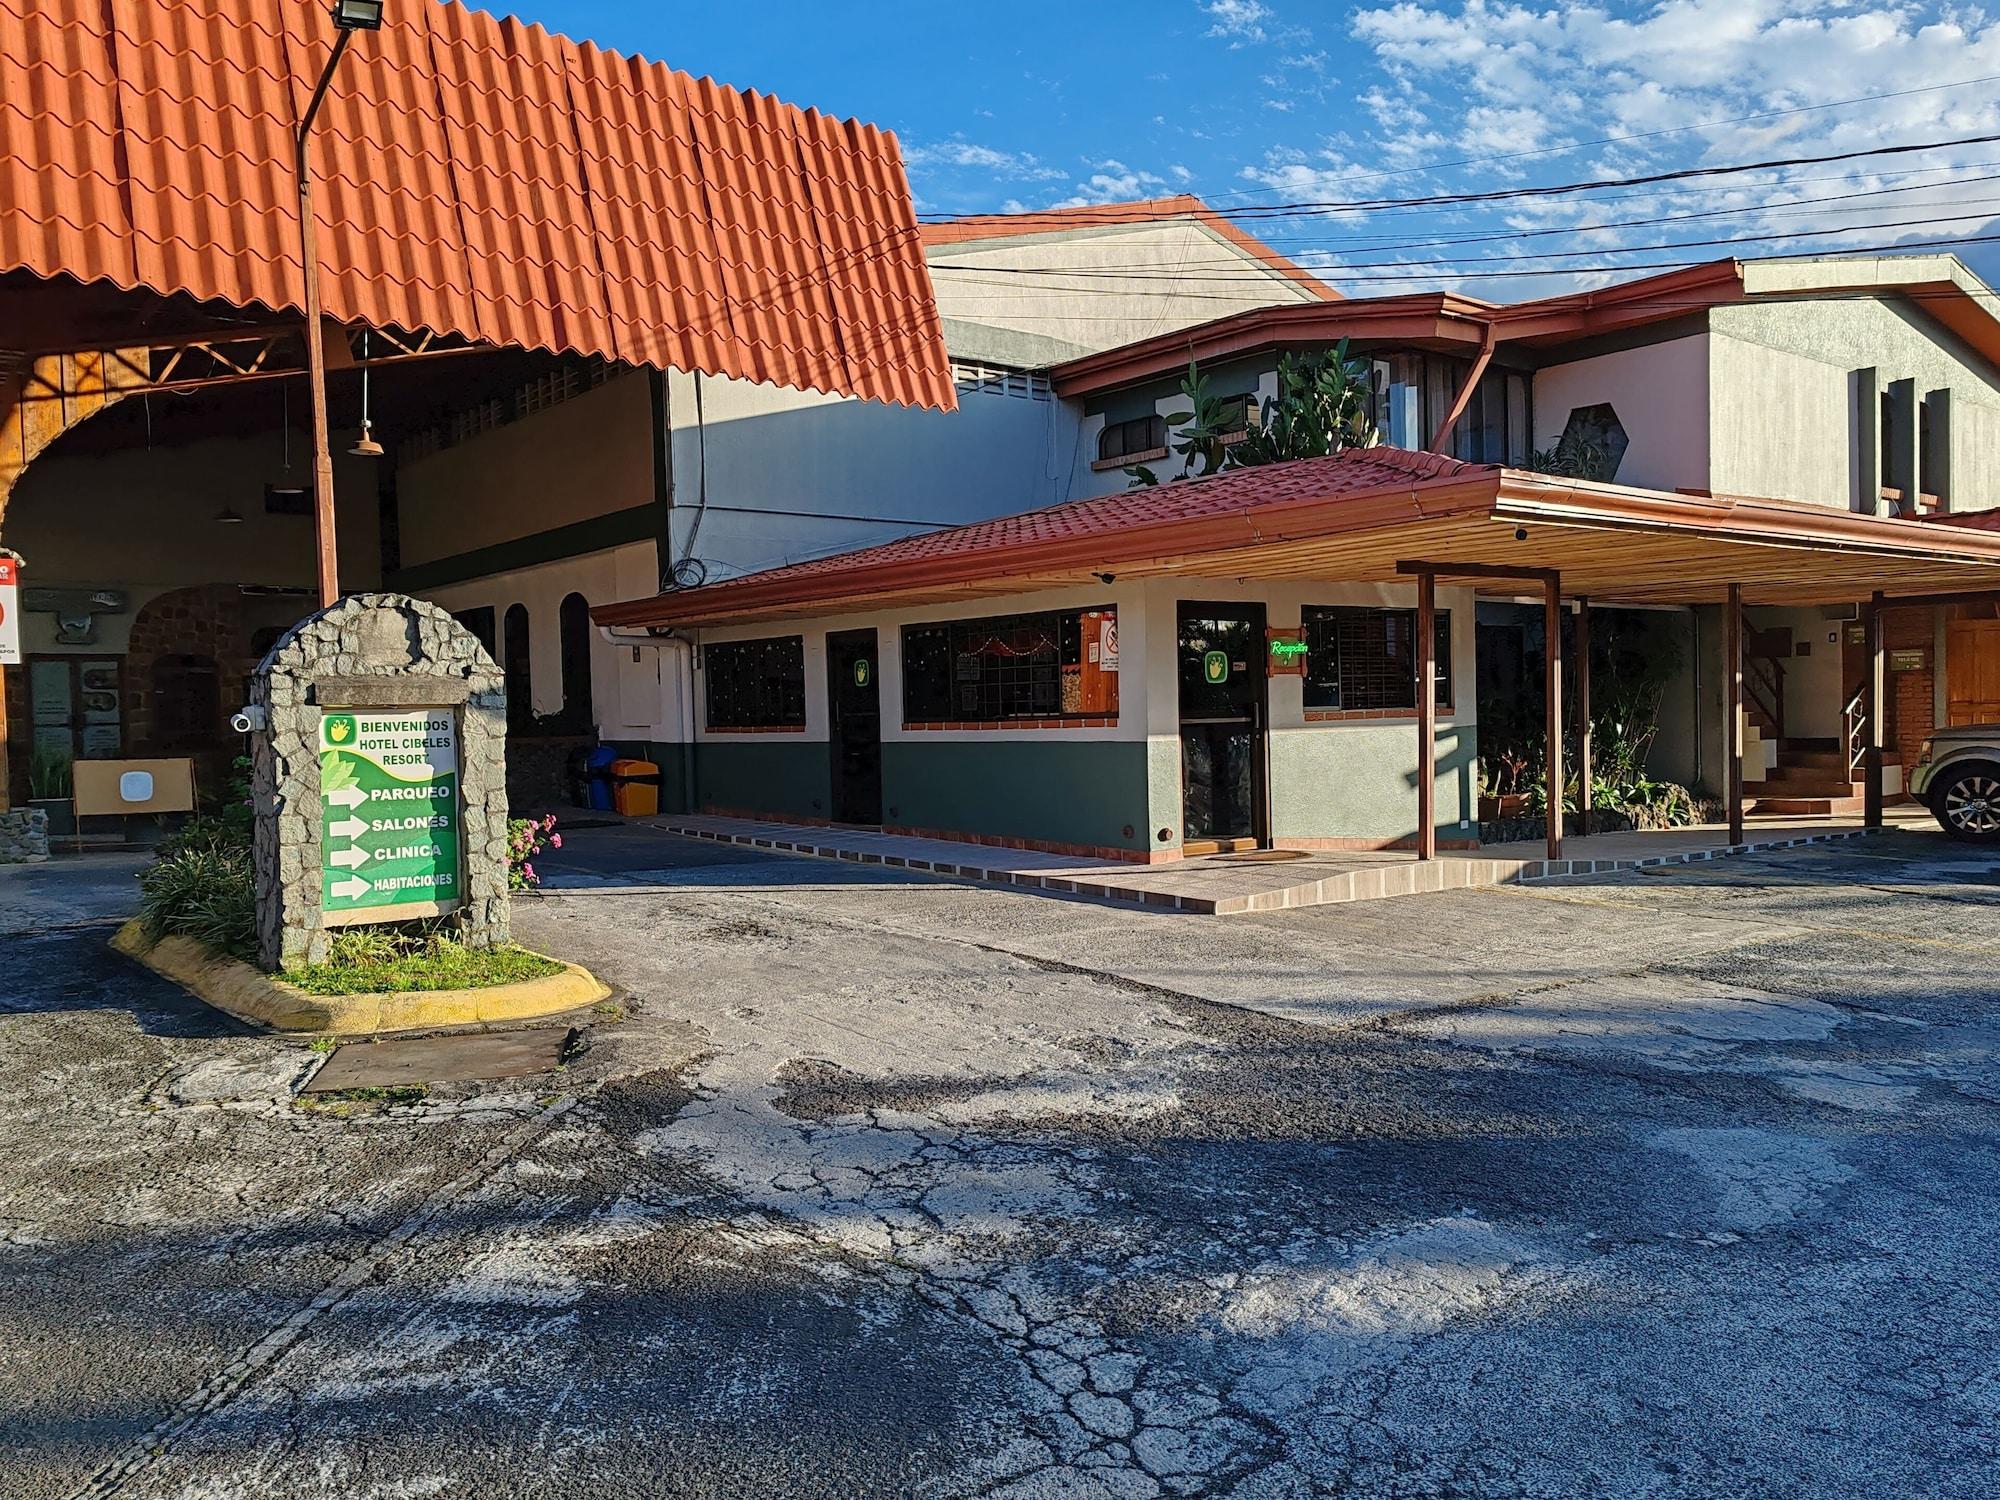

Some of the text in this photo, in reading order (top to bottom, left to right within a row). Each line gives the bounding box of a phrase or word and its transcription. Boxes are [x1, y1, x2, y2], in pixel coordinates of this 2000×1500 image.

[361, 720, 449, 733] BIENVENIDOS
[359, 737, 451, 750] HOTEL CIBELES
[383, 753, 430, 766] RESORT
[371, 786, 450, 801] PARQUEO
[372, 816, 449, 831] SALONES
[374, 845, 442, 860] CLINICA
[374, 873, 453, 891] HABITACIONES
